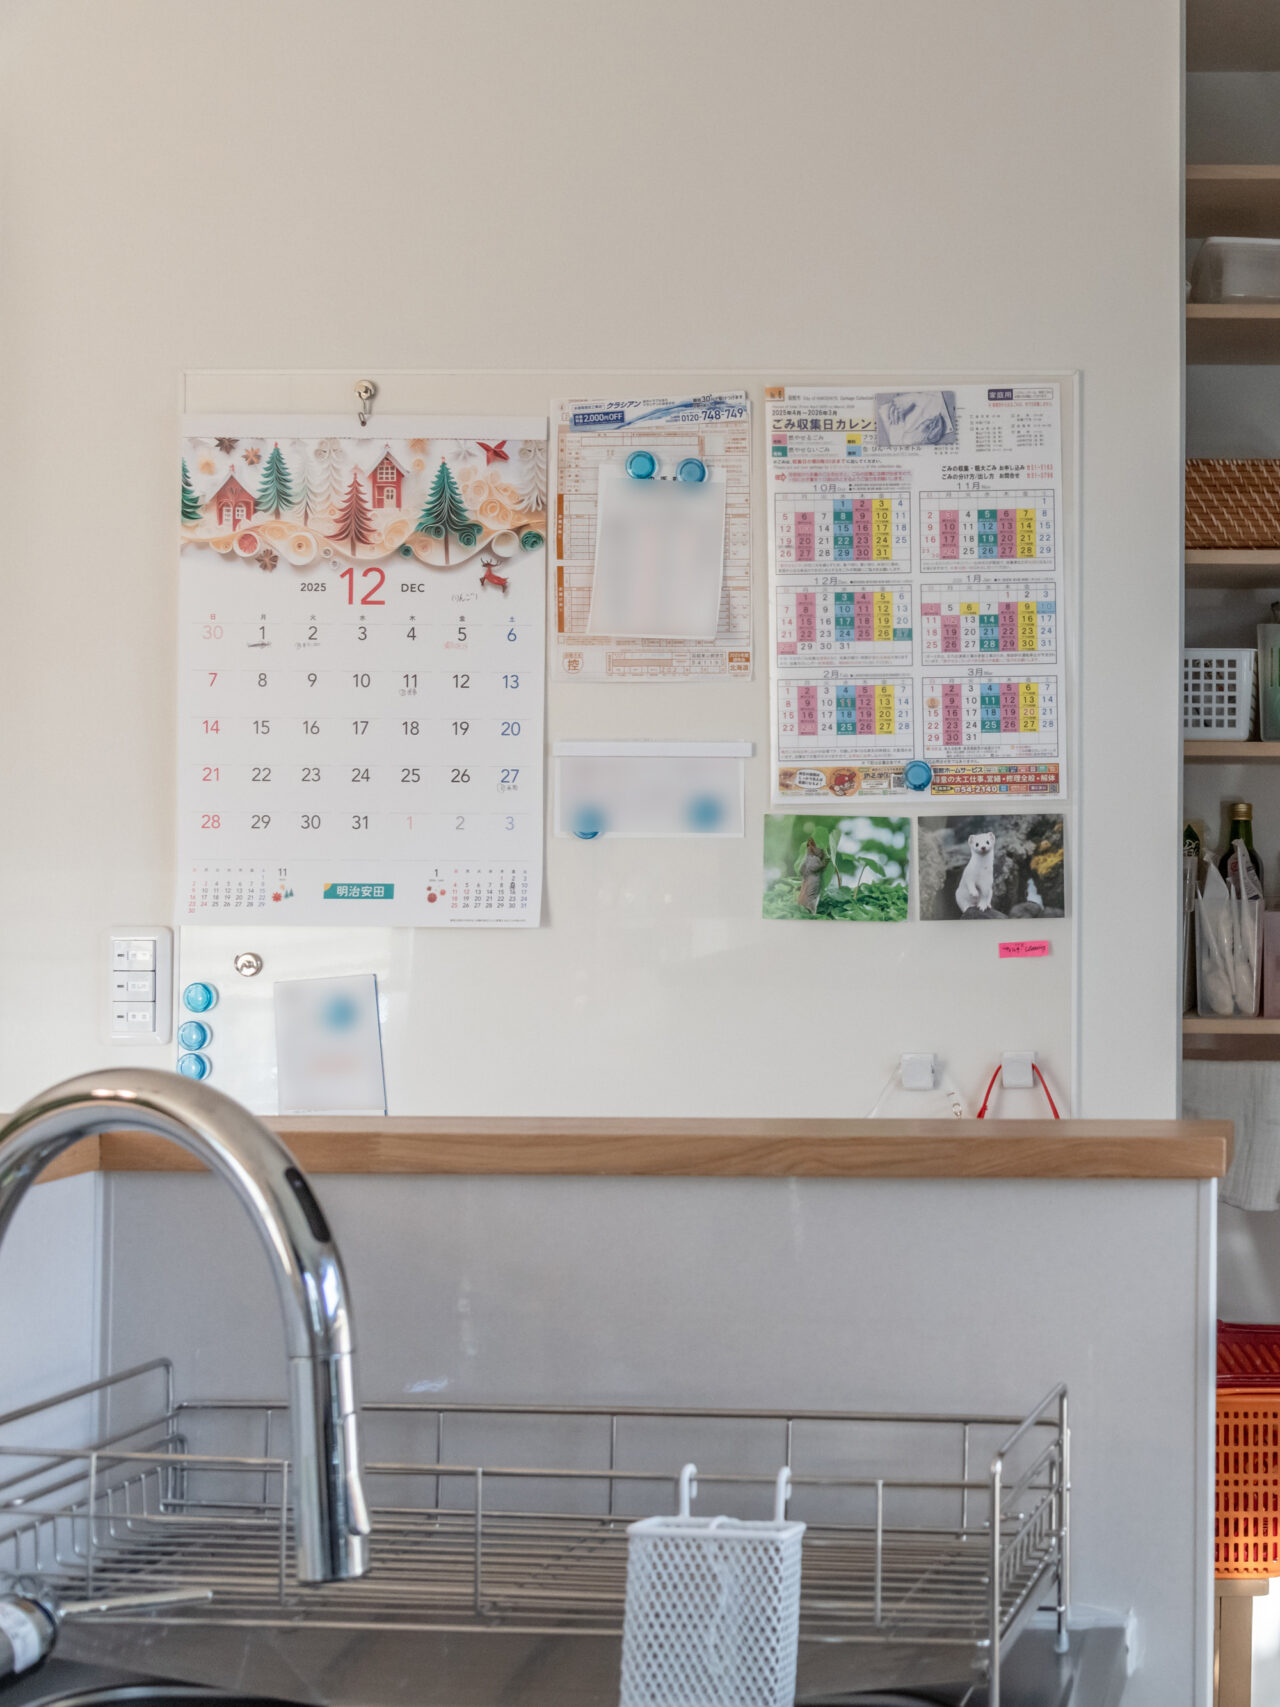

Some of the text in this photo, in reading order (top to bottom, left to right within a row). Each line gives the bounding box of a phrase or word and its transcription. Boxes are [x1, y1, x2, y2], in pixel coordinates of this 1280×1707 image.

[607, 401, 641, 410] クラシアン
[681, 407, 744, 422] 0120-748-749
[772, 419, 877, 430] ごみ収集日カレン
[300, 567, 425, 605] 2025 12 DEC
[409, 614, 416, 622] 木
[203, 625, 517, 642] 30 1 2 3 4 5 6
[568, 659, 580, 671] 控
[208, 673, 520, 689] 7 8 9 10 11 12 13
[202, 720, 521, 736] 14 15 16 17 18 19 20
[202, 767, 520, 783] 21 22 23 24 25 26 27
[201, 815, 515, 831] 28 29 30 31 1 2 3
[278, 868, 287, 877] 11
[435, 869, 438, 877] 1
[336, 885, 385, 897] 明治安田
